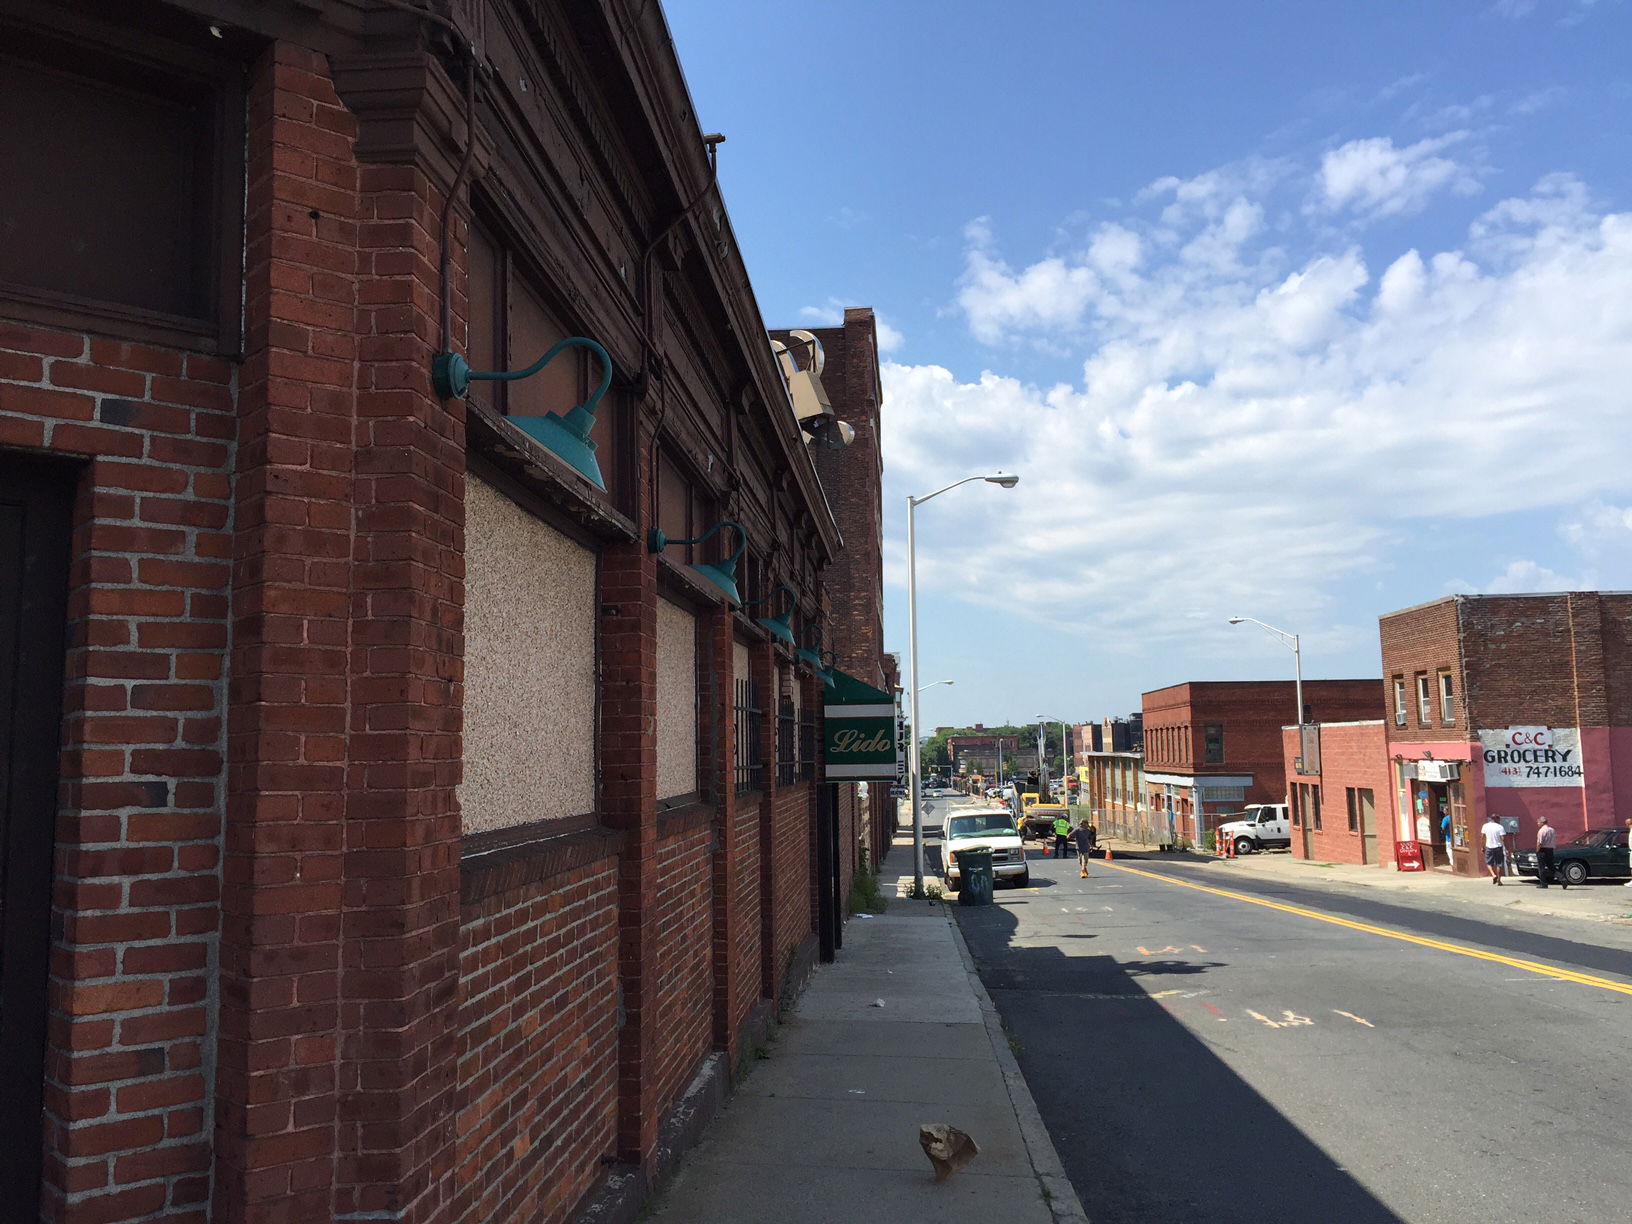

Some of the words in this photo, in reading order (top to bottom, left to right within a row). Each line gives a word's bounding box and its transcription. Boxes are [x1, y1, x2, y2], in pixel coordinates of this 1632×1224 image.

[830, 729, 891, 752] Lido
[1511, 732, 1546, 746] C&C
[1483, 749, 1572, 763] GROCERY
